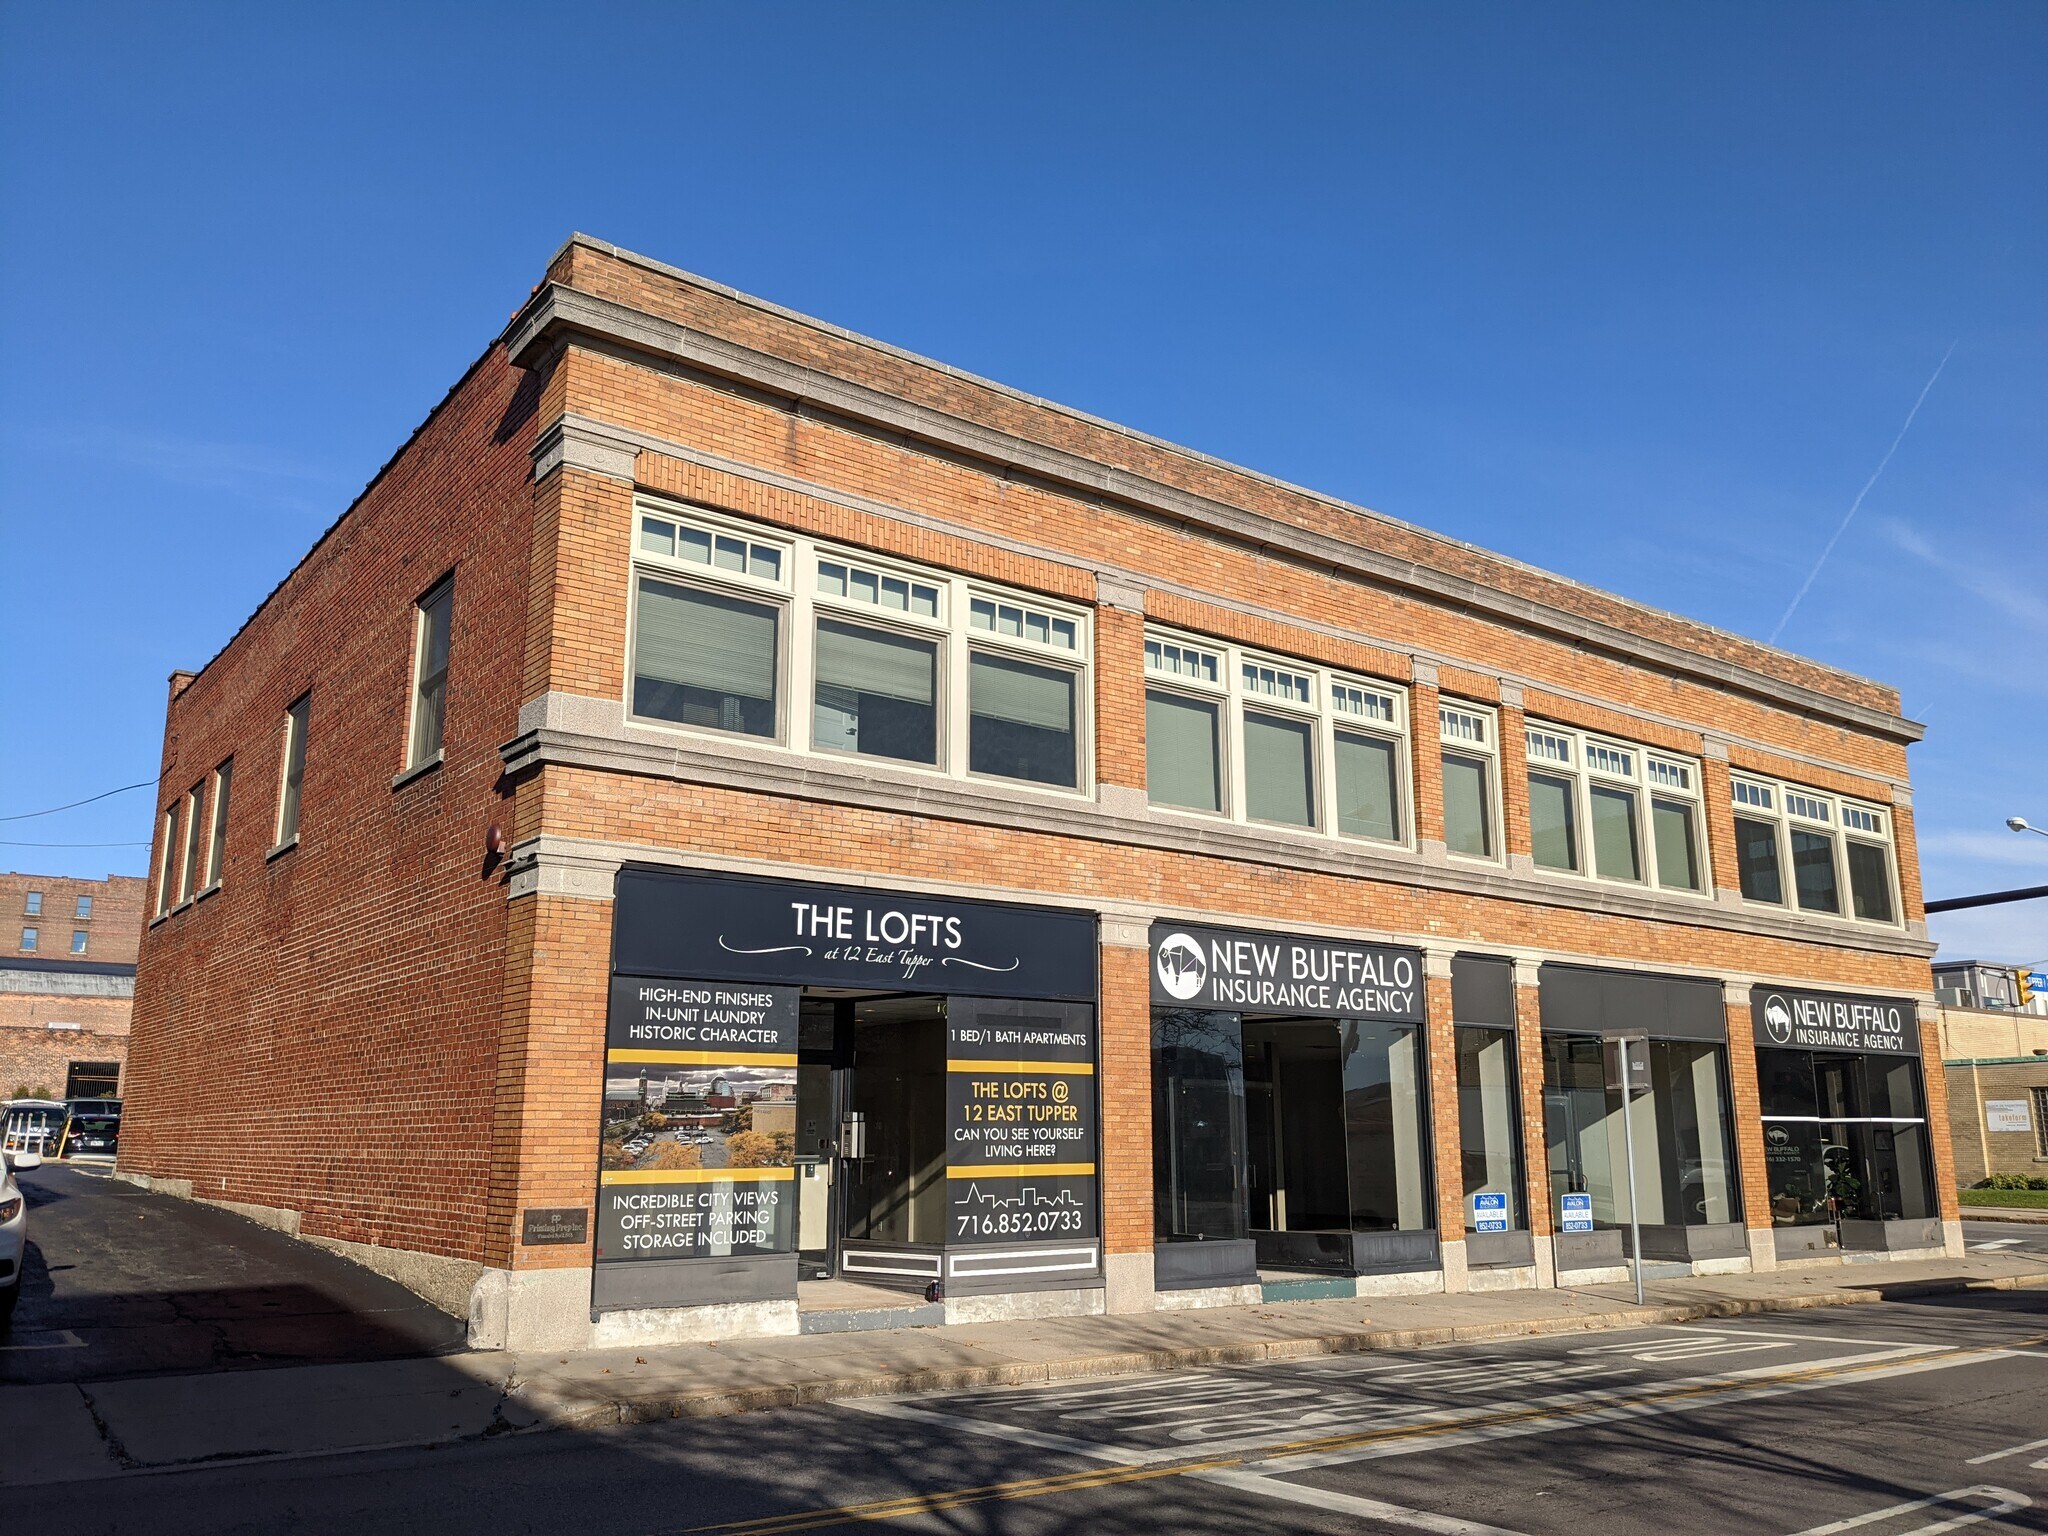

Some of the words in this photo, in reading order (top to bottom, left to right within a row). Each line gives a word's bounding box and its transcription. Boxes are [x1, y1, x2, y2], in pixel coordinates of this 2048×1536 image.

[791, 902, 854, 940] THE
[866, 910, 962, 949] LOFTS
[824, 947, 840, 960] at
[843, 946, 861, 961] 12
[865, 947, 894, 964] East
[898, 948, 933, 979] Tupper
[1211, 938, 1280, 978] NEW
[1291, 946, 1413, 989] BUFFALO
[639, 987, 712, 1004] HIGH-END
[715, 991, 773, 1007] FINISHES
[1212, 977, 1331, 1009] INSURANCE
[1336, 986, 1413, 1014] AGENCY
[645, 1006, 699, 1022] IN-UNIT
[704, 1009, 765, 1024] LAUNDRY
[1793, 999, 1831, 1027] NEW
[1834, 1002, 1901, 1033] BUFFALO
[630, 1024, 696, 1041] HISTORIC
[700, 1027, 778, 1043] CHARACTER
[951, 1029, 956, 1041] 1
[960, 1029, 991, 1045] BED/1
[996, 1031, 1021, 1043] BATH
[1023, 1032, 1087, 1046] APARTMENTS
[1795, 1028, 1860, 1047] INSURANCE
[1864, 1033, 1903, 1050] AGENCY
[971, 1081, 999, 1098] THE
[1003, 1081, 1047, 1099] LOFTS
[1052, 1081, 1069, 1103] @
[964, 1104, 982, 1121] 12
[987, 1104, 1023, 1121] EAST
[1027, 1105, 1078, 1121] TUPPER
[954, 1128, 980, 1141] CAN
[983, 1128, 1008, 1141] YOU
[1011, 1127, 1029, 1140] SEE
[1032, 1127, 1084, 1140] YOURSELF
[985, 1144, 1023, 1157] LIVING
[1026, 1144, 1056, 1157] HERE?
[613, 1194, 694, 1210] INCREDIBLE
[698, 1192, 729, 1207] CITY
[733, 1190, 779, 1206] VIEWS
[621, 1212, 704, 1229] OFF-STREET
[708, 1210, 770, 1226] PARKING
[957, 1210, 1082, 1236] 716.852.0733
[1476, 1210, 1503, 1218] AVAILABLE
[528, 1224, 555, 1233] Printing
[1479, 1221, 1502, 1230] 852-0733
[1565, 1221, 1588, 1230] 852-0733
[623, 1232, 693, 1250] STORAGE
[698, 1230, 766, 1246] INCLUDED
